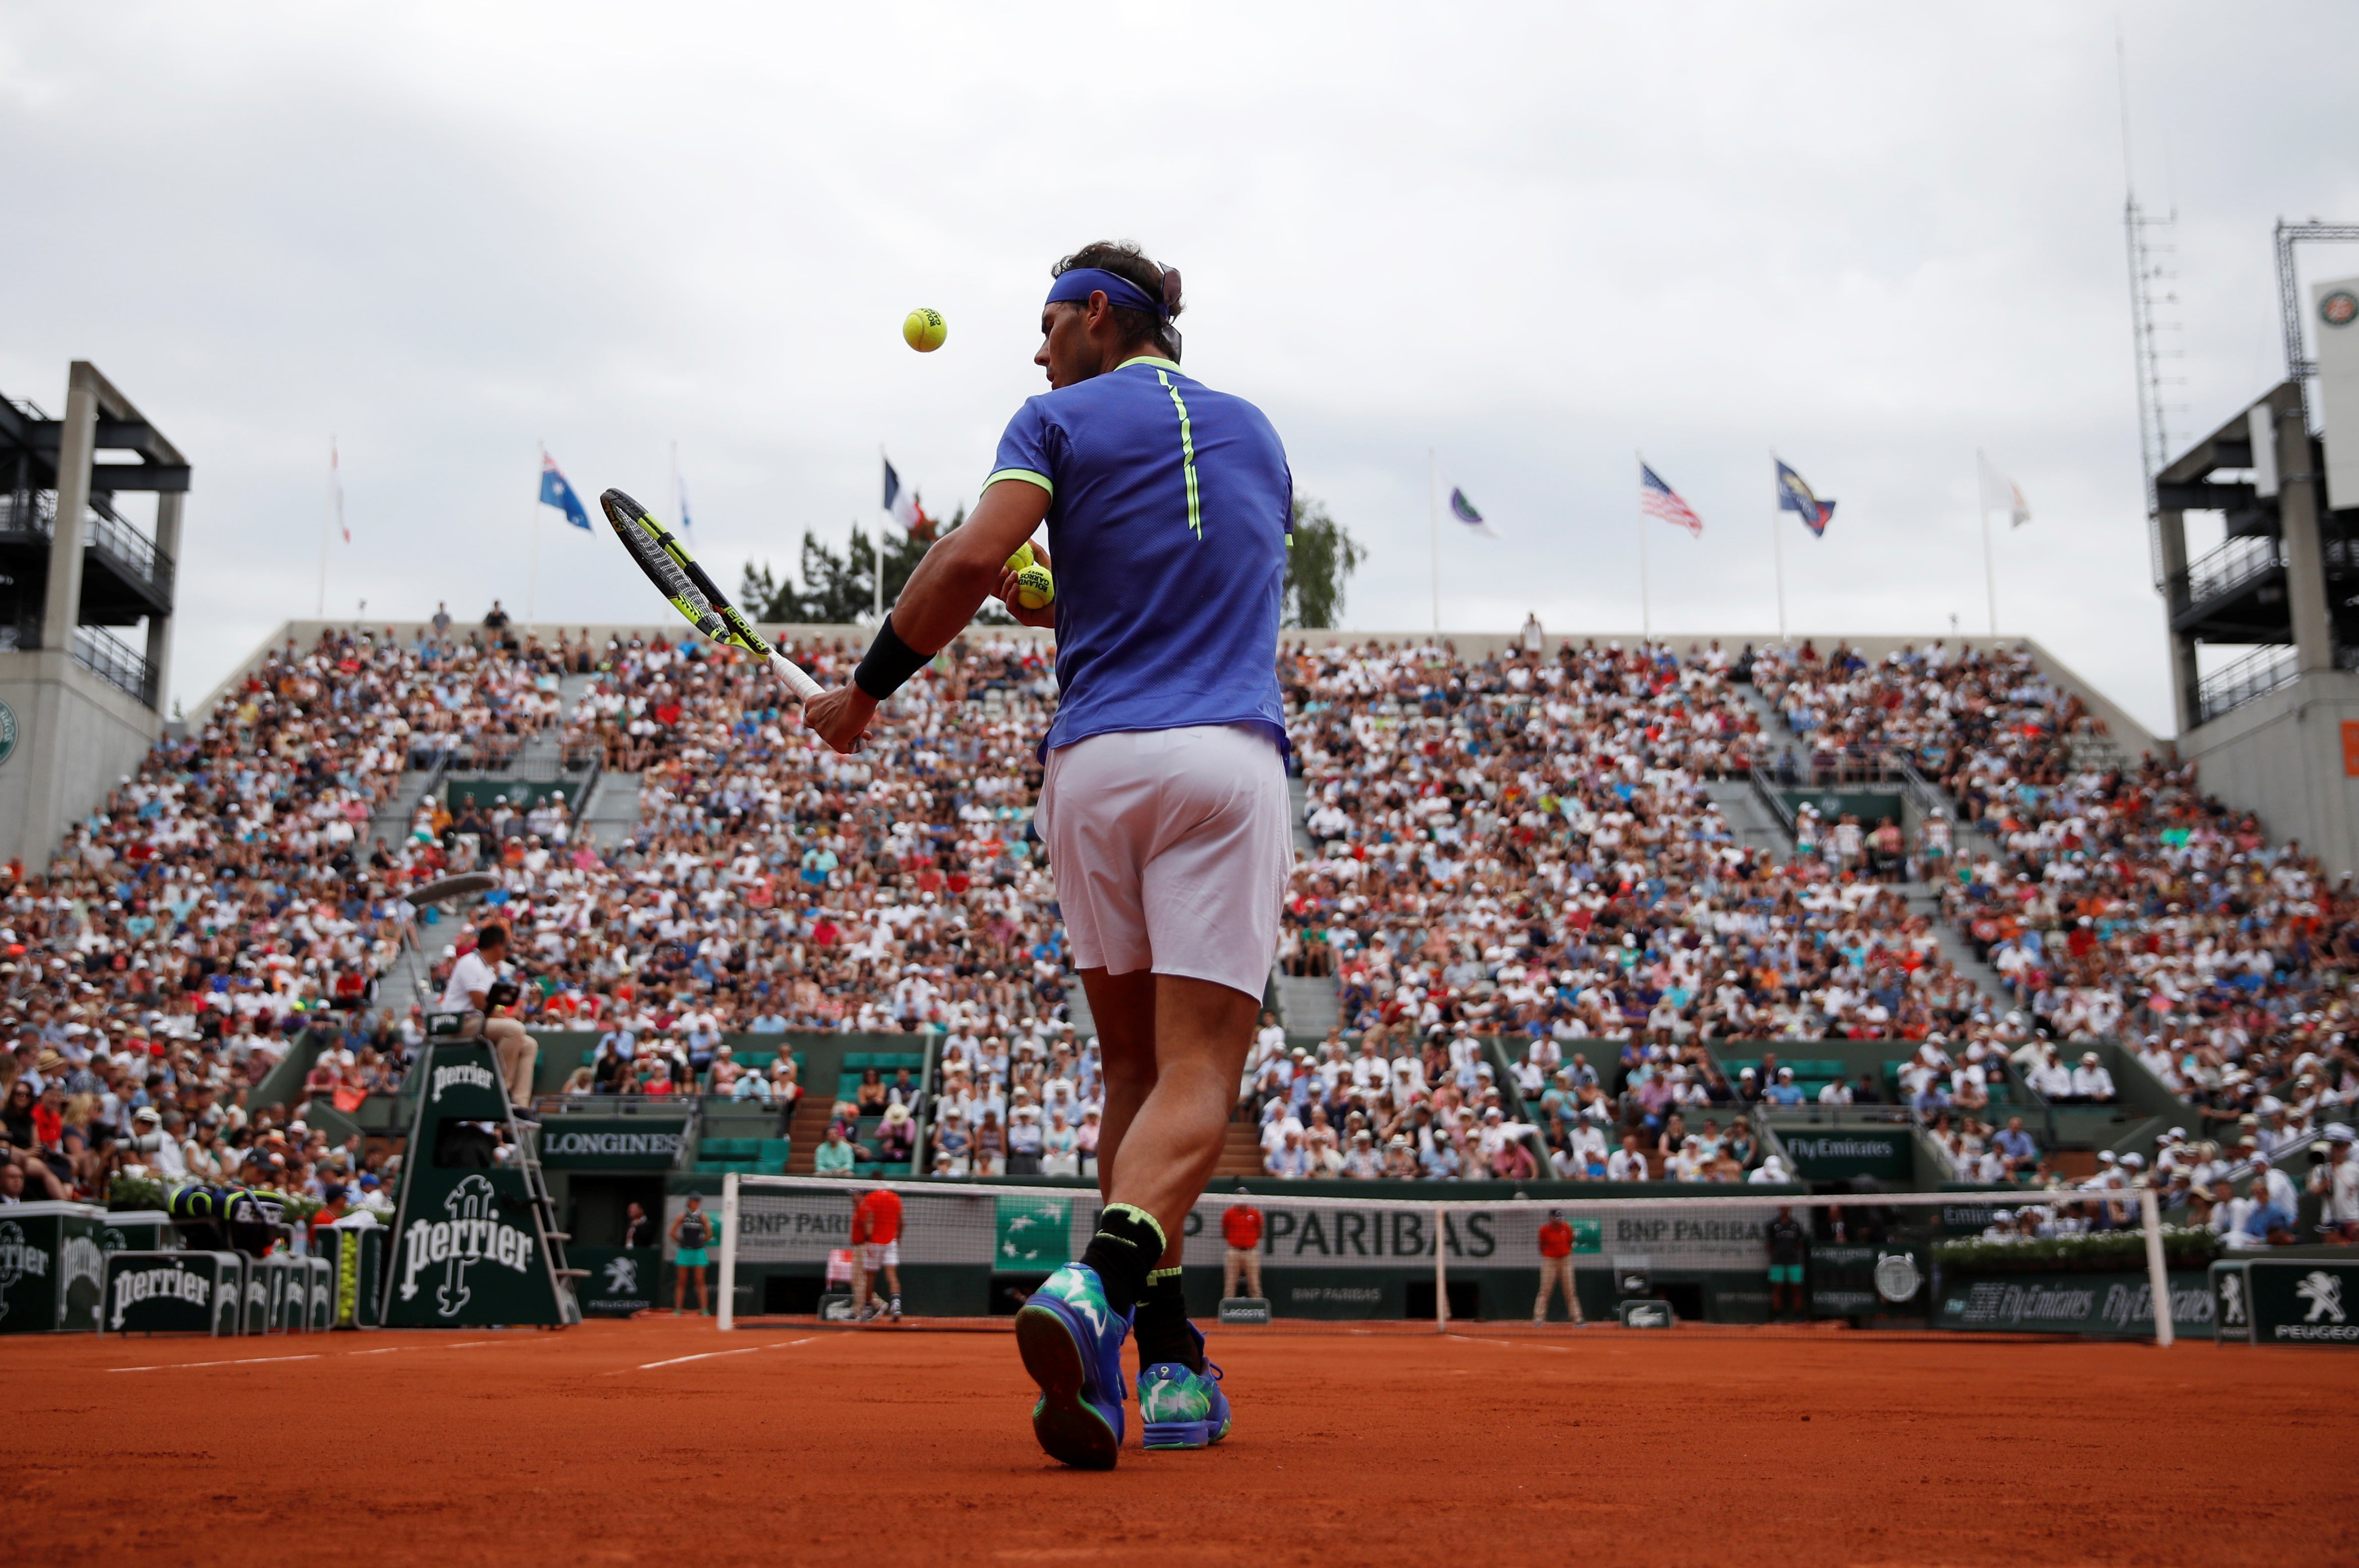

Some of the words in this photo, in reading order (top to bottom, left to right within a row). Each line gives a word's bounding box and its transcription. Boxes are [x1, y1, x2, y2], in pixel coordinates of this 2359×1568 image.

[1019, 579, 1048, 592] ROLAND
[1020, 573, 1049, 586] GARROS
[720, 606, 767, 651] Babolat
[431, 1060, 494, 1103] perrier
[544, 1133, 681, 1155] LONGINES
[1788, 1138, 1816, 1159] Fly
[1818, 1137, 1893, 1157] Emirates
[741, 1213, 789, 1233] BNP
[796, 1213, 852, 1233] PARI
[1264, 1211, 1495, 1257] PARIBAS
[1616, 1219, 1669, 1241] BNP
[1673, 1219, 1761, 1241] PARIBA
[399, 1208, 534, 1302] perrier
[110, 1260, 210, 1330] perrier
[1161, 1366, 1169, 1377] 9
